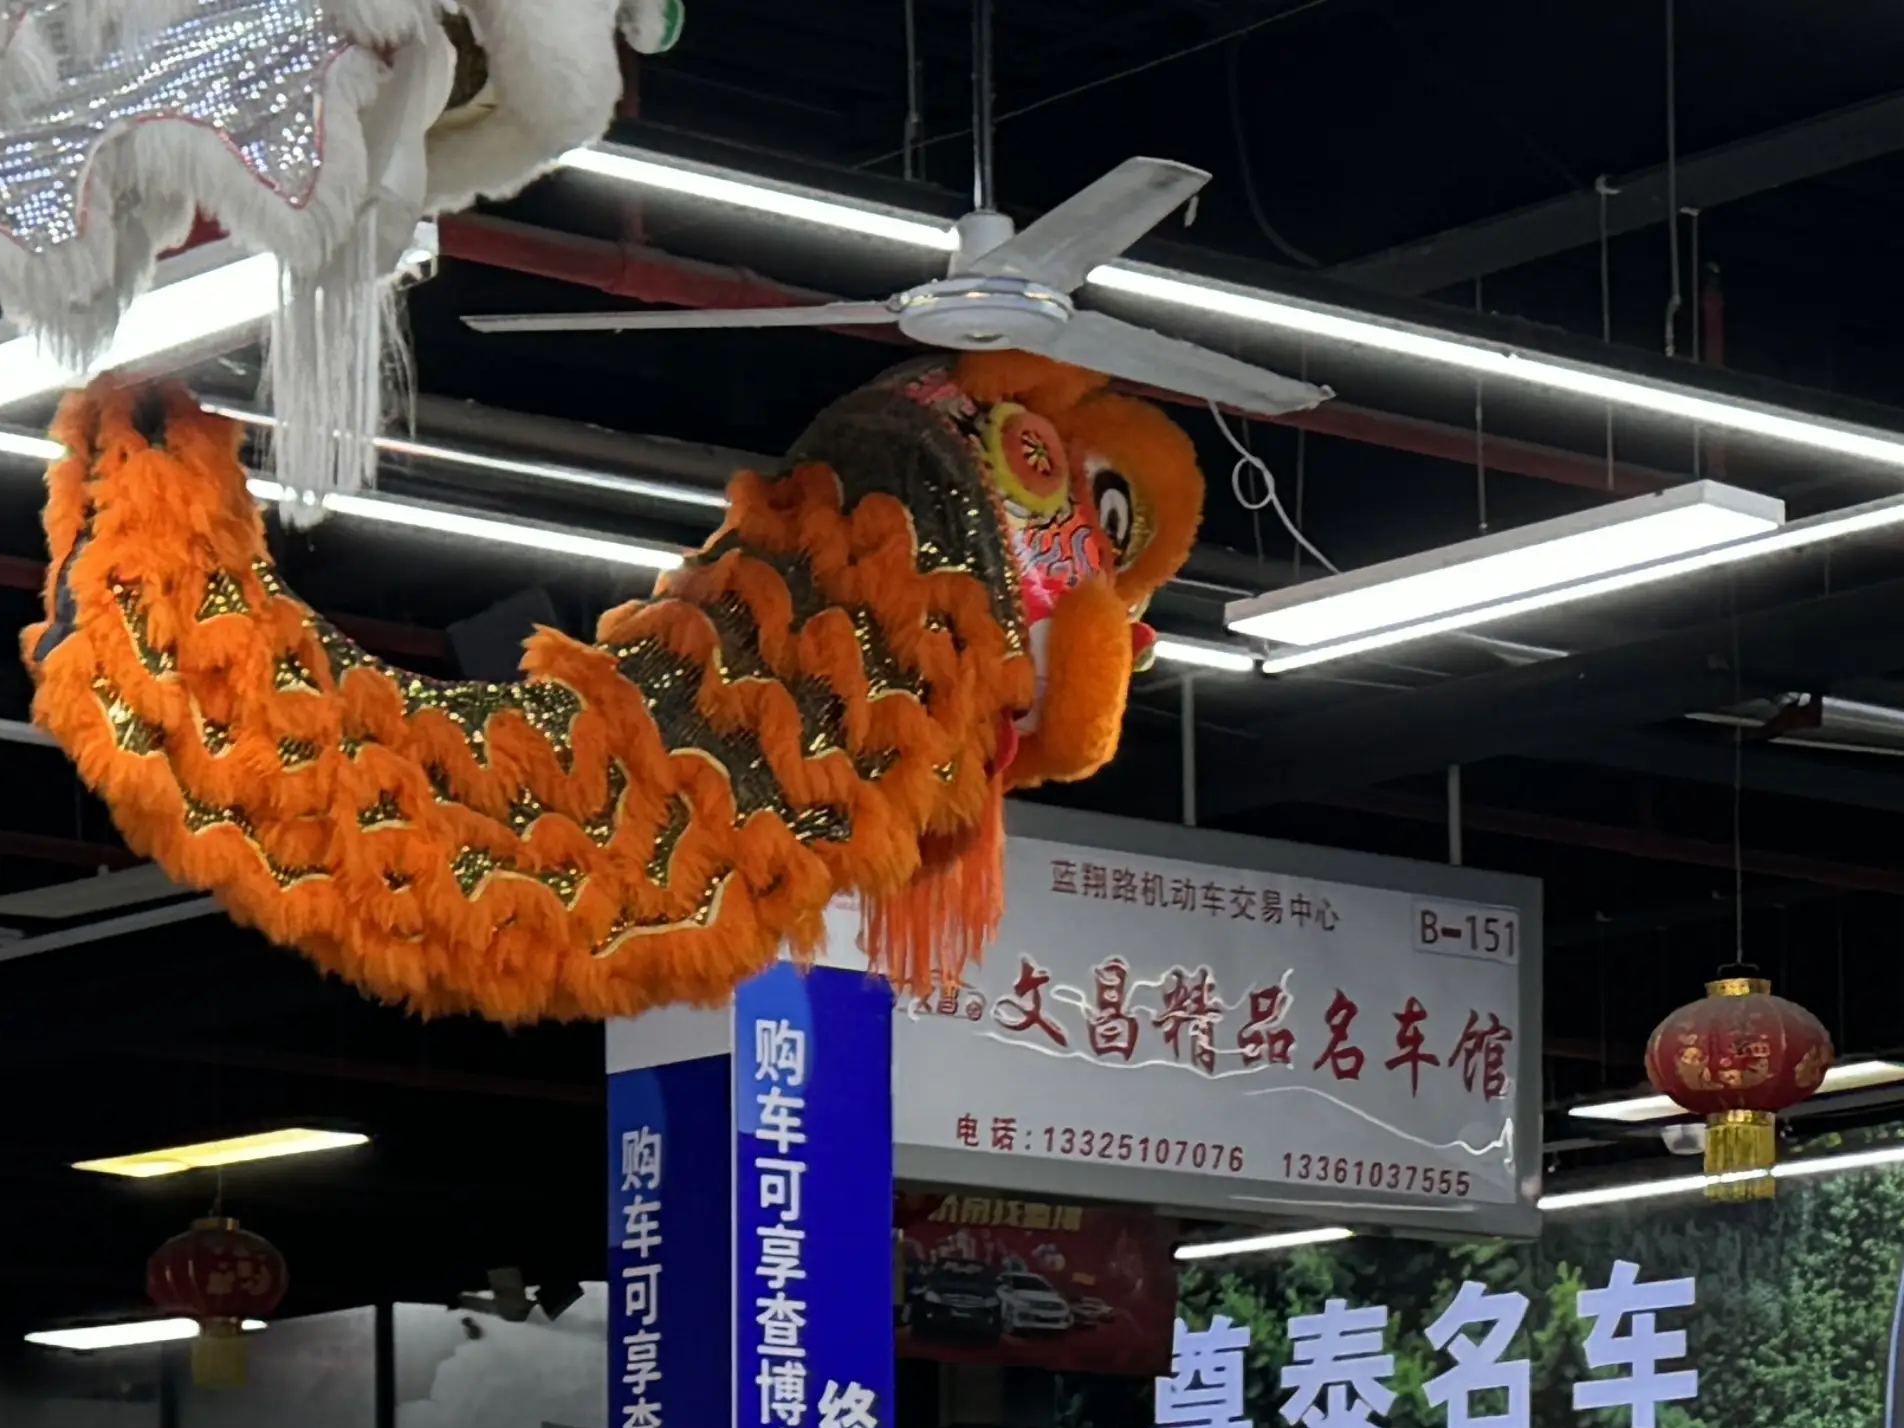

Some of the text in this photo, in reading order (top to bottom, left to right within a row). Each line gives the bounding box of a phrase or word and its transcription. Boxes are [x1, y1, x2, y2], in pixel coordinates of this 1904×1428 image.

[1050, 859, 1340, 933] 蓝翔路机动车交易中心
[992, 954, 1514, 1101] 文昌精品名车馆
[1282, 1151, 1472, 1198] 13361037555
